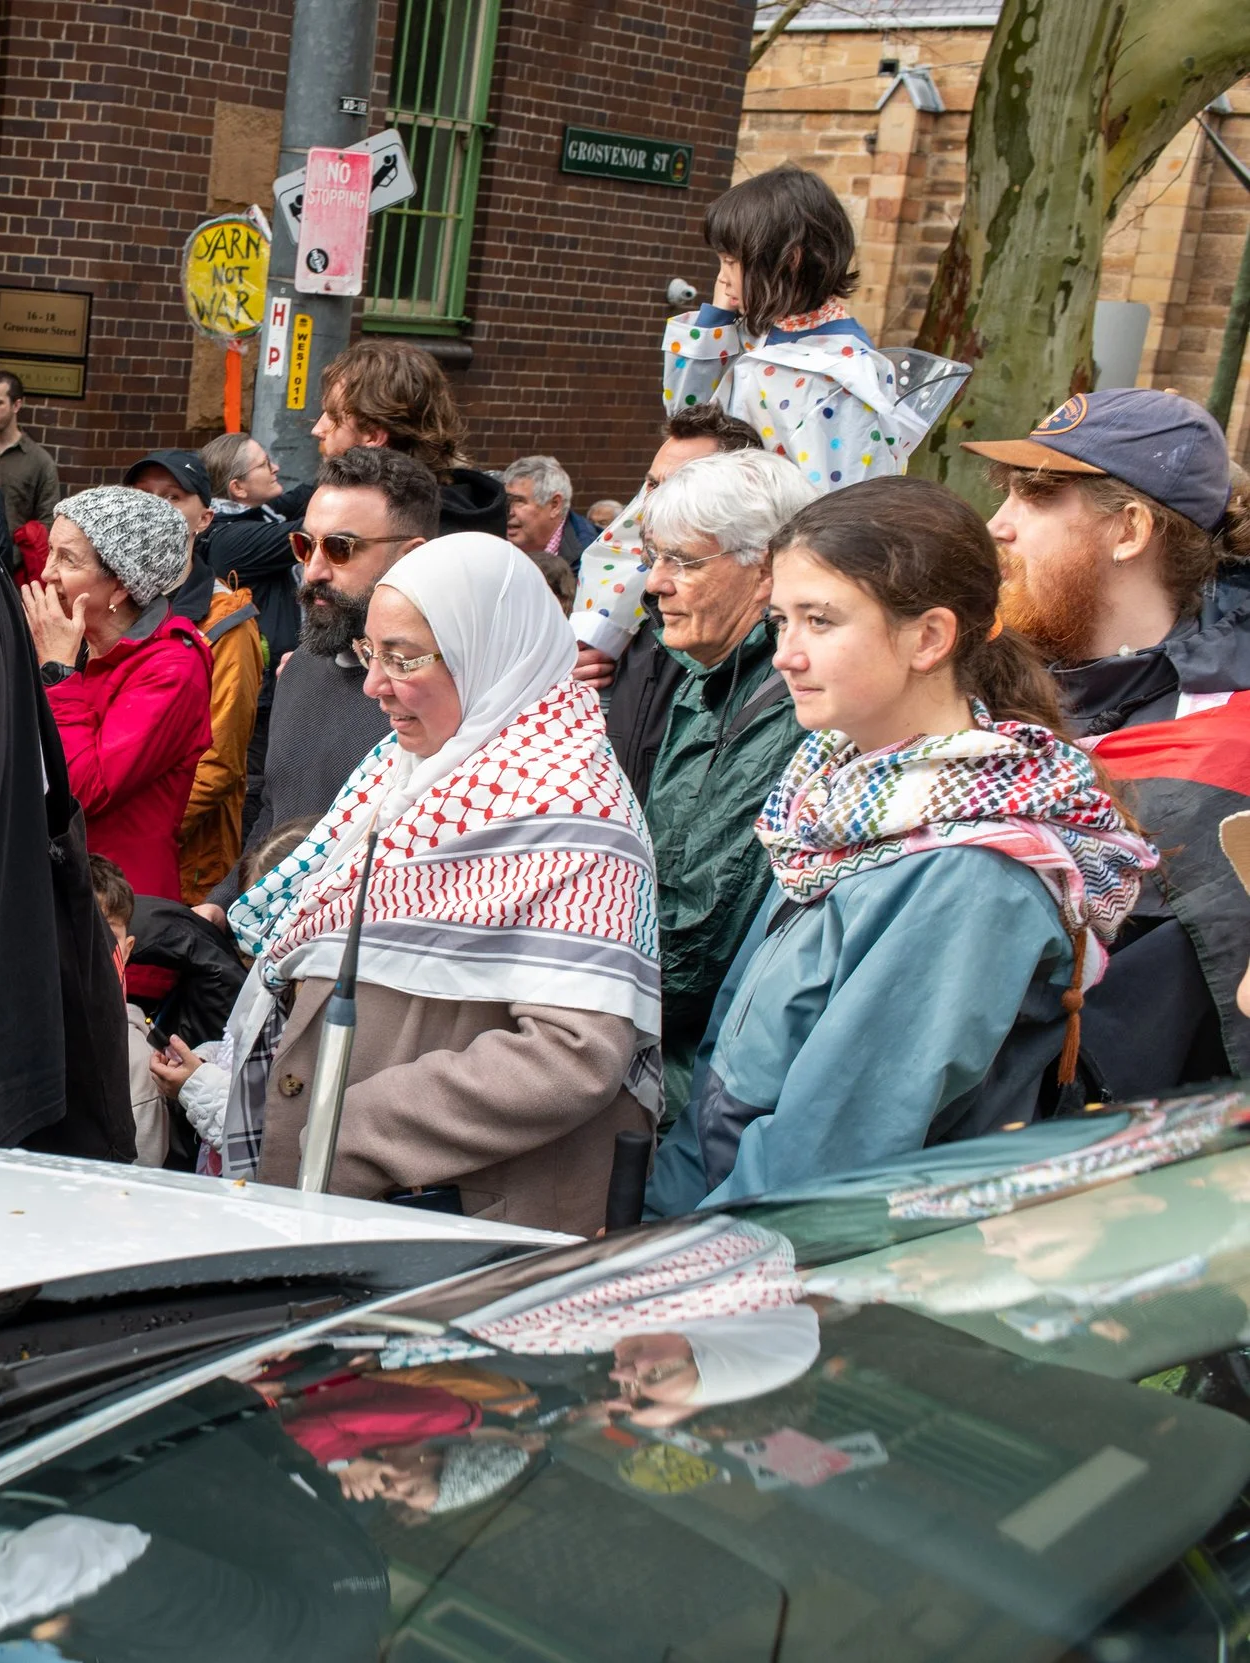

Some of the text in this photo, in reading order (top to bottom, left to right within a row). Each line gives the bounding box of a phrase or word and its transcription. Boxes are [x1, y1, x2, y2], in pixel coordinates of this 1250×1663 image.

[568, 140, 669, 172] GROSVENOR ST
[326, 162, 351, 184] NO
[308, 187, 366, 209] STOPPING
[195, 227, 262, 262] YARN
[212, 262, 249, 287] NOT
[190, 290, 257, 330] WAR
[51, 325, 77, 337] Street
